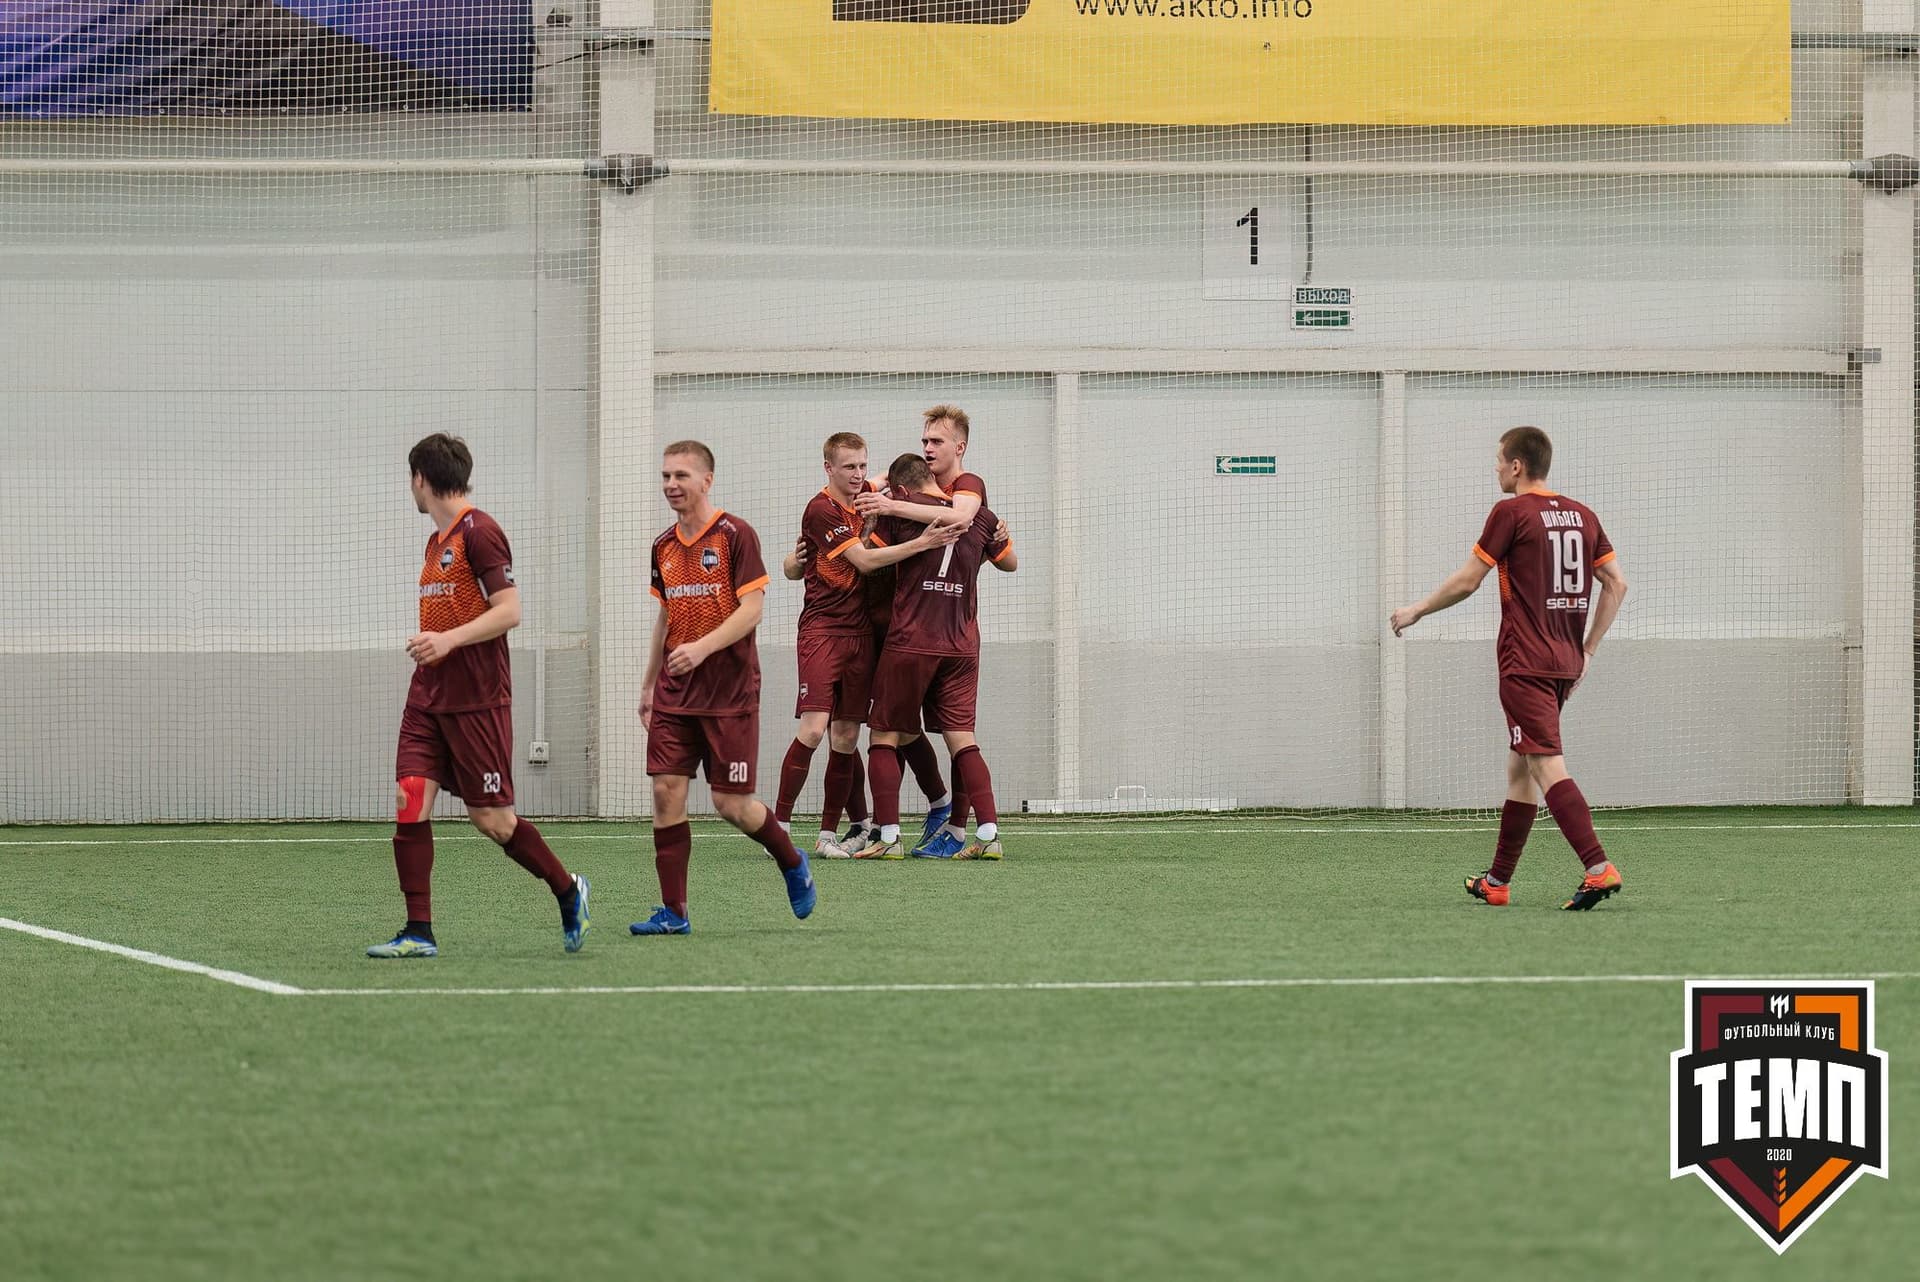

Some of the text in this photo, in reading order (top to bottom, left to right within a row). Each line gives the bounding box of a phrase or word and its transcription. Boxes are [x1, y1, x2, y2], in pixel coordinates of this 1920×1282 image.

[1076, 0, 1313, 18] www.akto.info
[1236, 207, 1258, 265] 1
[1299, 290, 1349, 302] ВЫХОД
[1548, 530, 1584, 594] 19
[922, 580, 964, 594] SEUS
[1546, 597, 1588, 609] SEUS
[729, 762, 748, 783] 20
[484, 773, 500, 793] 23
